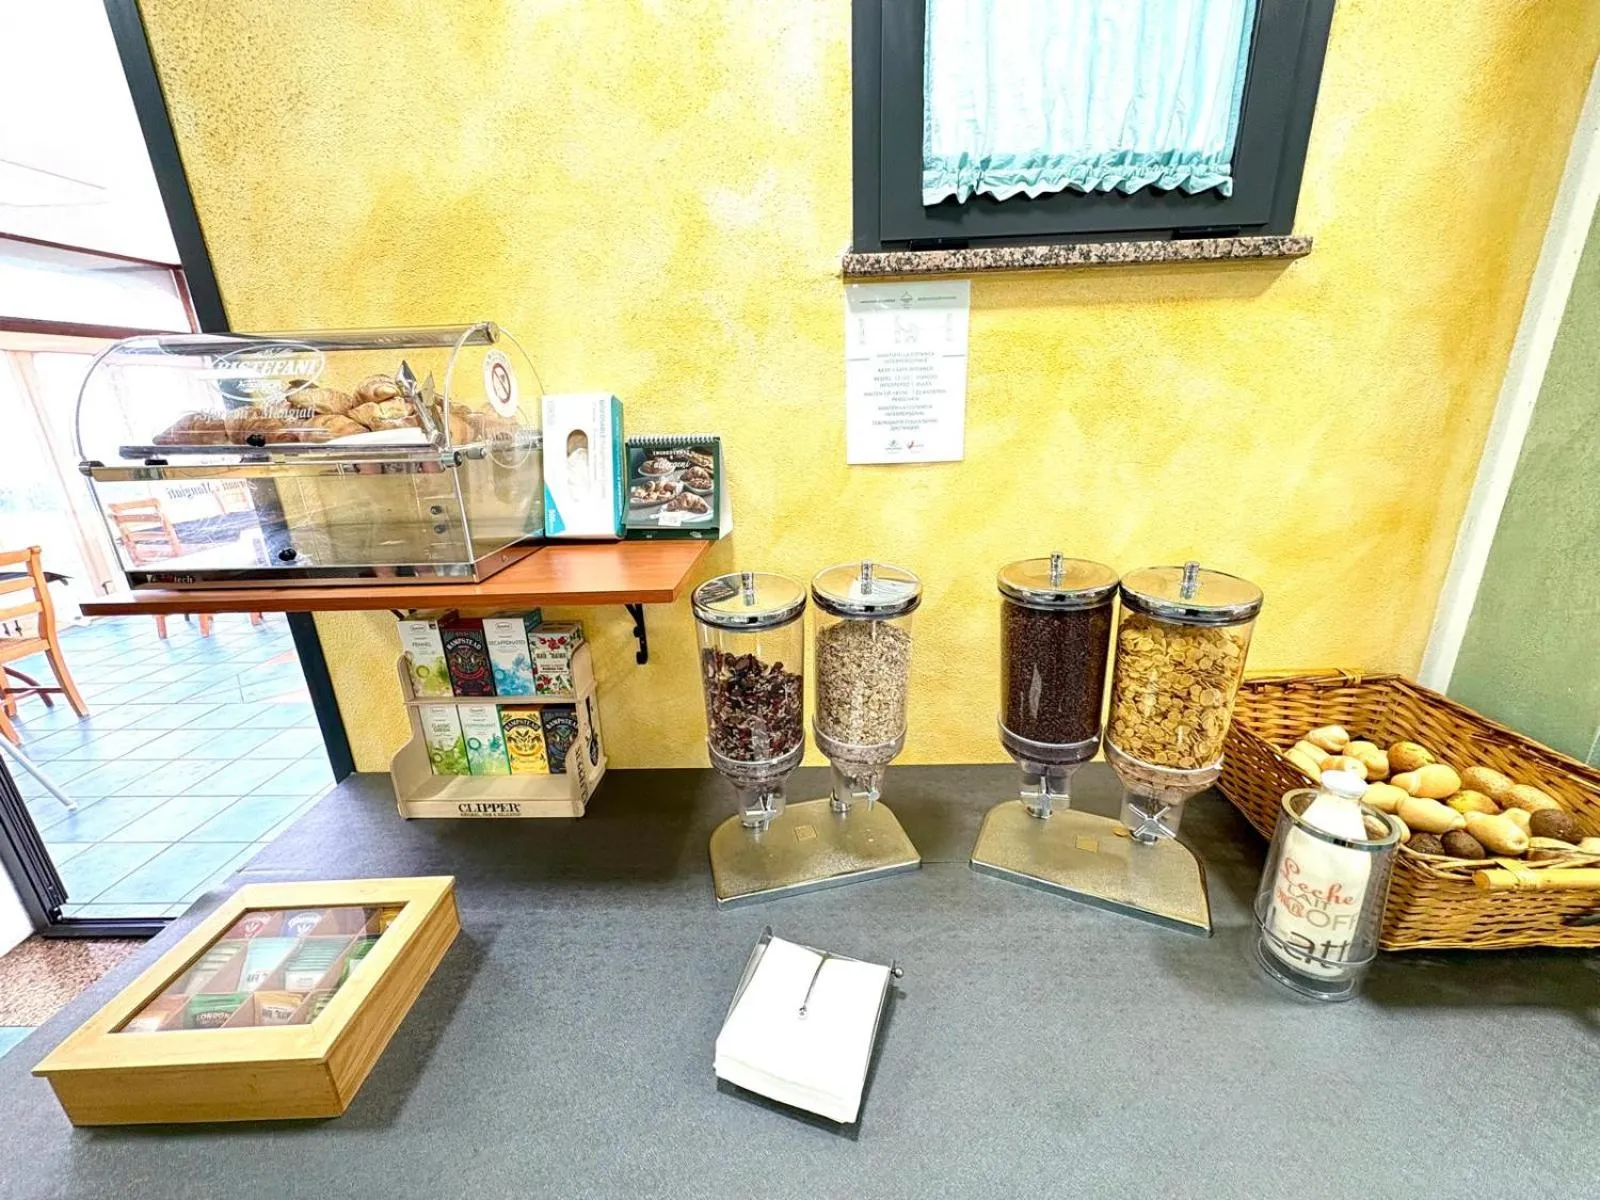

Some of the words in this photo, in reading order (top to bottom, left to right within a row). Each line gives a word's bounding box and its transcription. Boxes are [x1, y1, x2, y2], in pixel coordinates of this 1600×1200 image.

[446, 637, 482, 651] HAMPSTEAD
[546, 718, 578, 730] HAMPSTEA
[458, 803, 520, 813] CLIPPER
[1281, 857, 1354, 905] Leche
